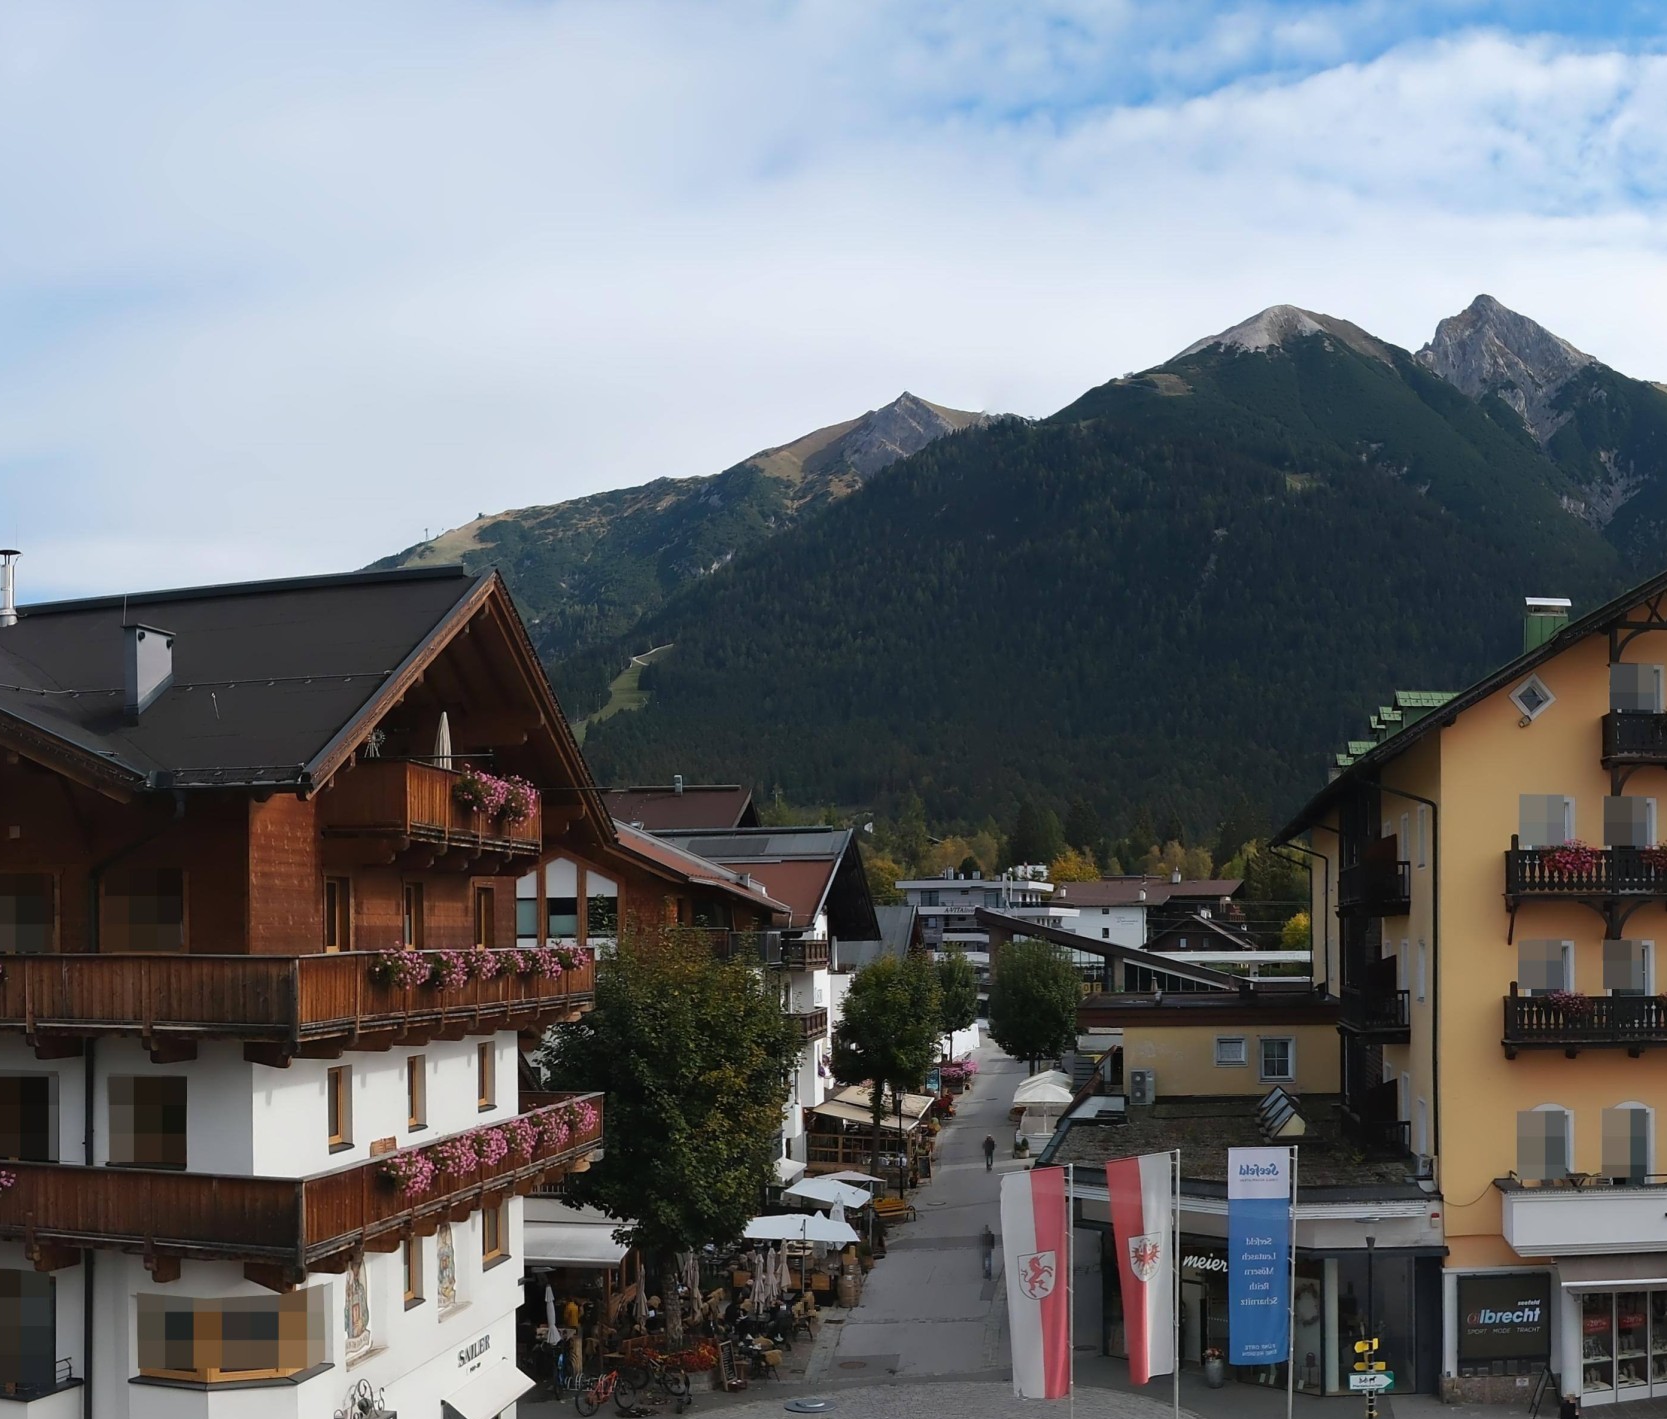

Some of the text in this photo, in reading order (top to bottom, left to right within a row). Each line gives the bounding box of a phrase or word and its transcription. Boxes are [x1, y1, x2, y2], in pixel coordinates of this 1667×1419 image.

[1183, 1253, 1228, 1272] meier
[1467, 1307, 1540, 1324] albrecht
[458, 1334, 490, 1368] SAILER
